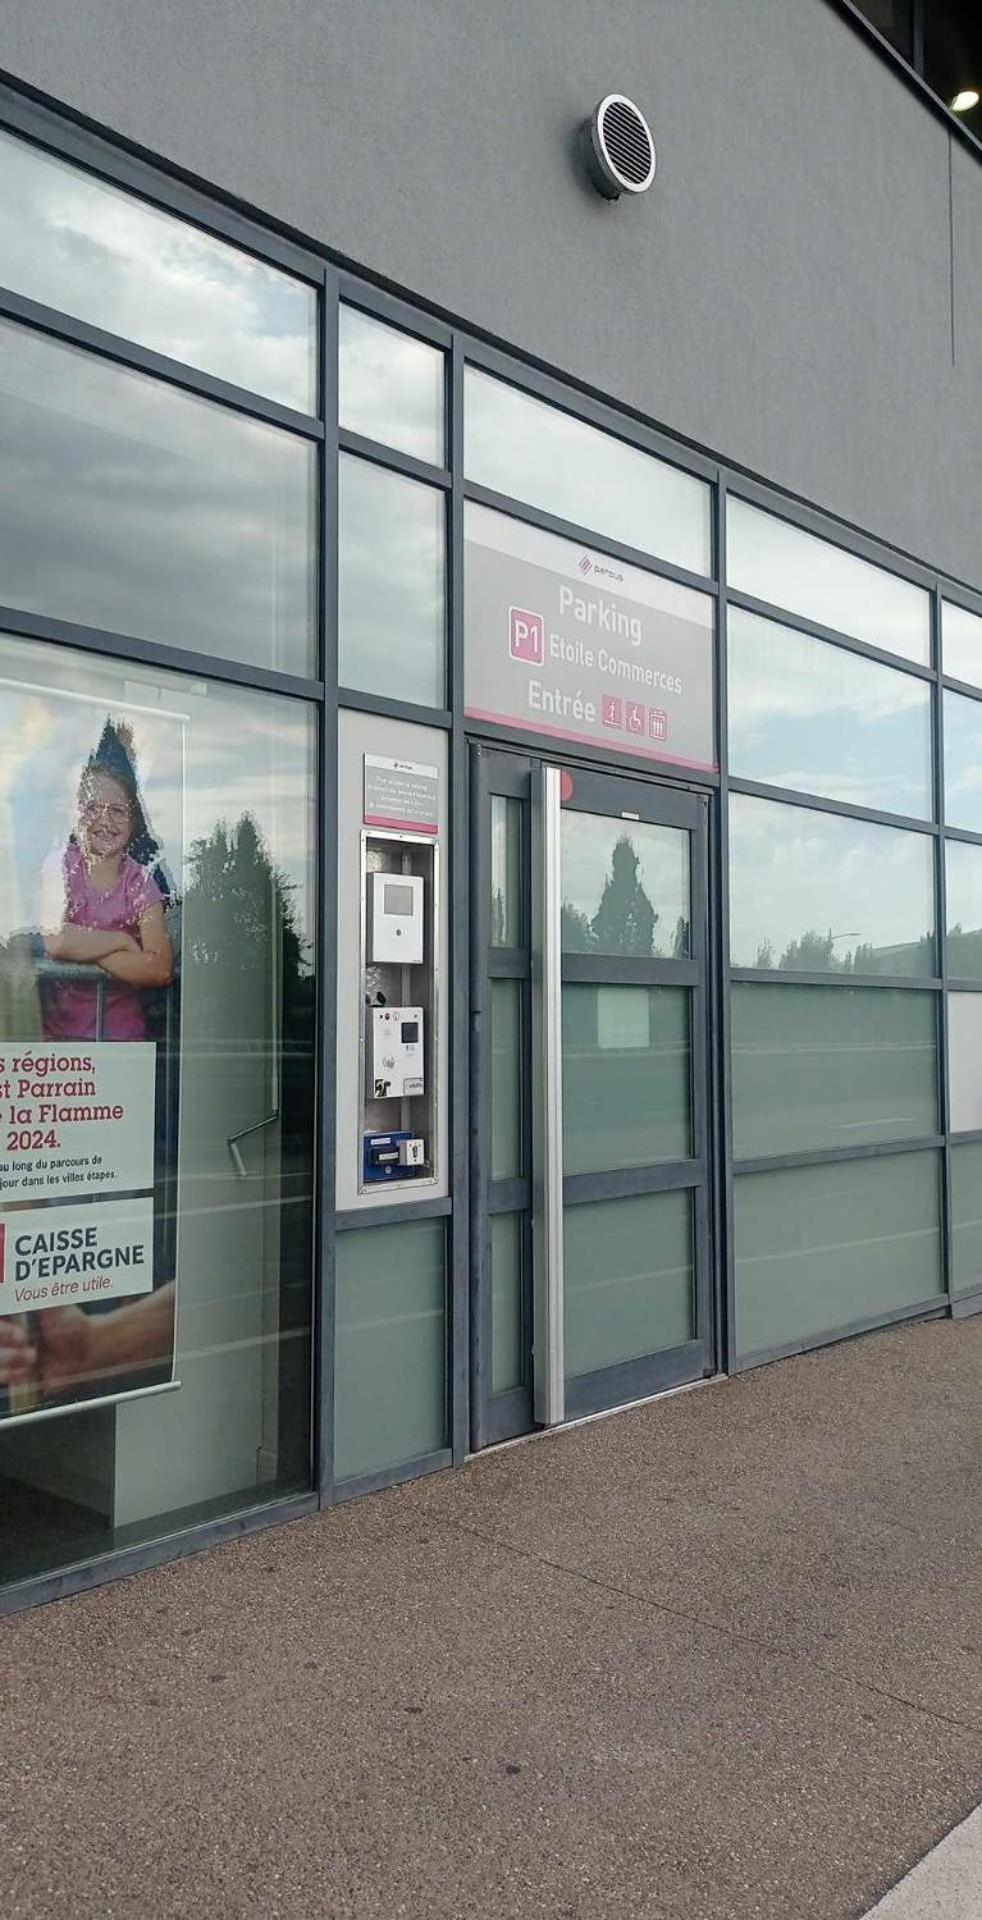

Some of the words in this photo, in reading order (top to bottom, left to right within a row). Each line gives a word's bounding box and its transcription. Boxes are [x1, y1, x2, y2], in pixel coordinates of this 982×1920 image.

[559, 585, 642, 646] Parking
[514, 619, 539, 653] P1
[549, 633, 595, 667] Etoile
[598, 649, 683, 694] Commerces
[528, 679, 596, 722] Entrée
[12, 1050, 96, 1077] régions,
[17, 1078, 96, 1098] Parrain
[9, 1106, 32, 1125] la
[39, 1104, 124, 1123] Flamme
[7, 1129, 61, 1151] 2024.
[12, 1160, 33, 1173] long
[36, 1159, 48, 1169] du
[50, 1158, 89, 1170] parcours
[92, 1155, 102, 1165] de
[21, 1174, 44, 1187] dans
[46, 1174, 60, 1185] les
[62, 1172, 84, 1183] villes
[14, 1226, 98, 1257] CAISSE
[15, 1245, 145, 1281] D'EPARGNE
[15, 1287, 48, 1302] Vous
[51, 1281, 78, 1297] être
[82, 1275, 113, 1293] utile.
